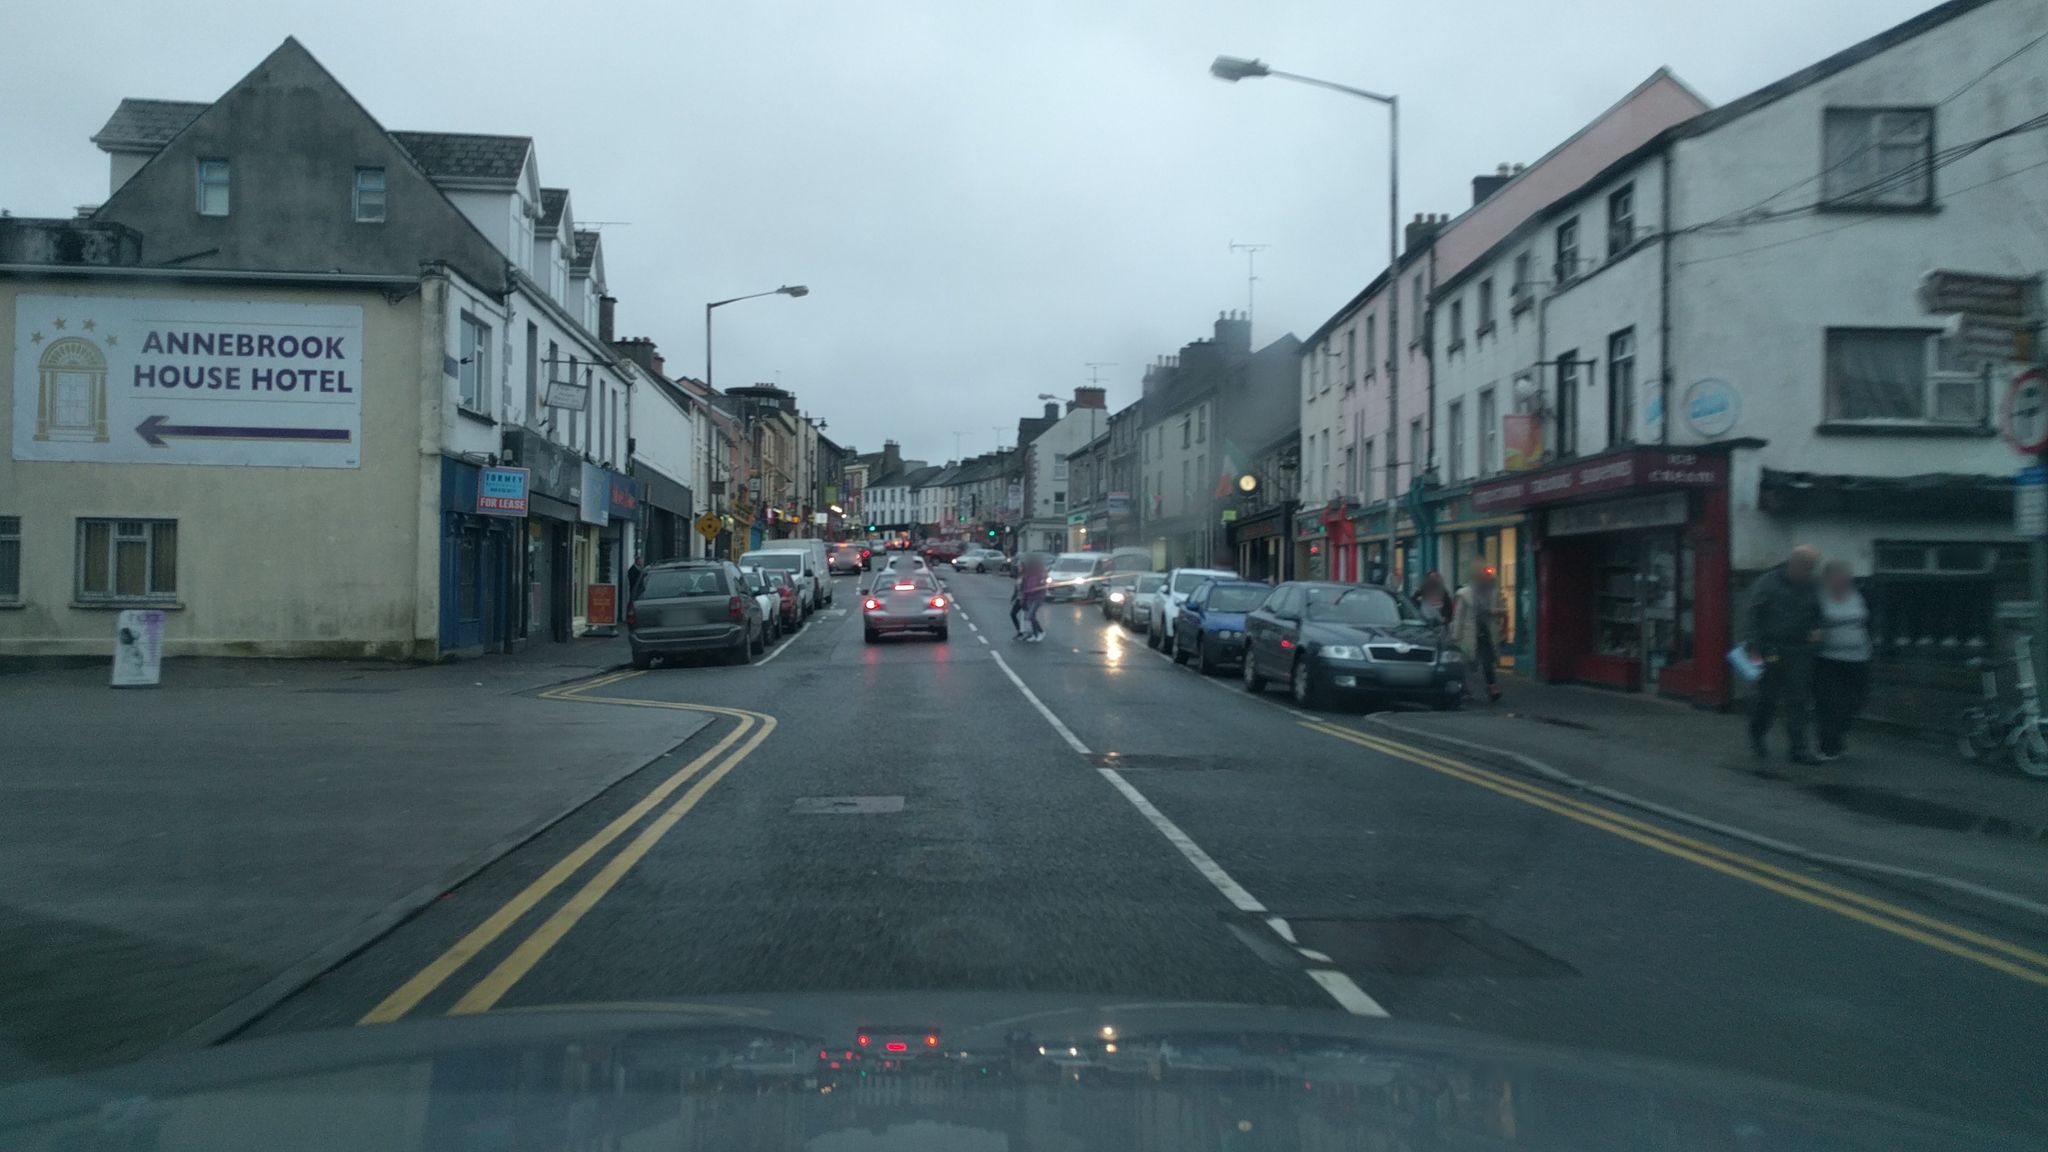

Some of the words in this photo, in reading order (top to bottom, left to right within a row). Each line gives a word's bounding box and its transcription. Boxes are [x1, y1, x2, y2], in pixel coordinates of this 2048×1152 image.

[141, 331, 345, 360] ANNEBROOK
[133, 365, 241, 390] HOUSE
[251, 368, 353, 393] HOTEL
[480, 496, 497, 507] FOR
[499, 498, 526, 510] LEASE
